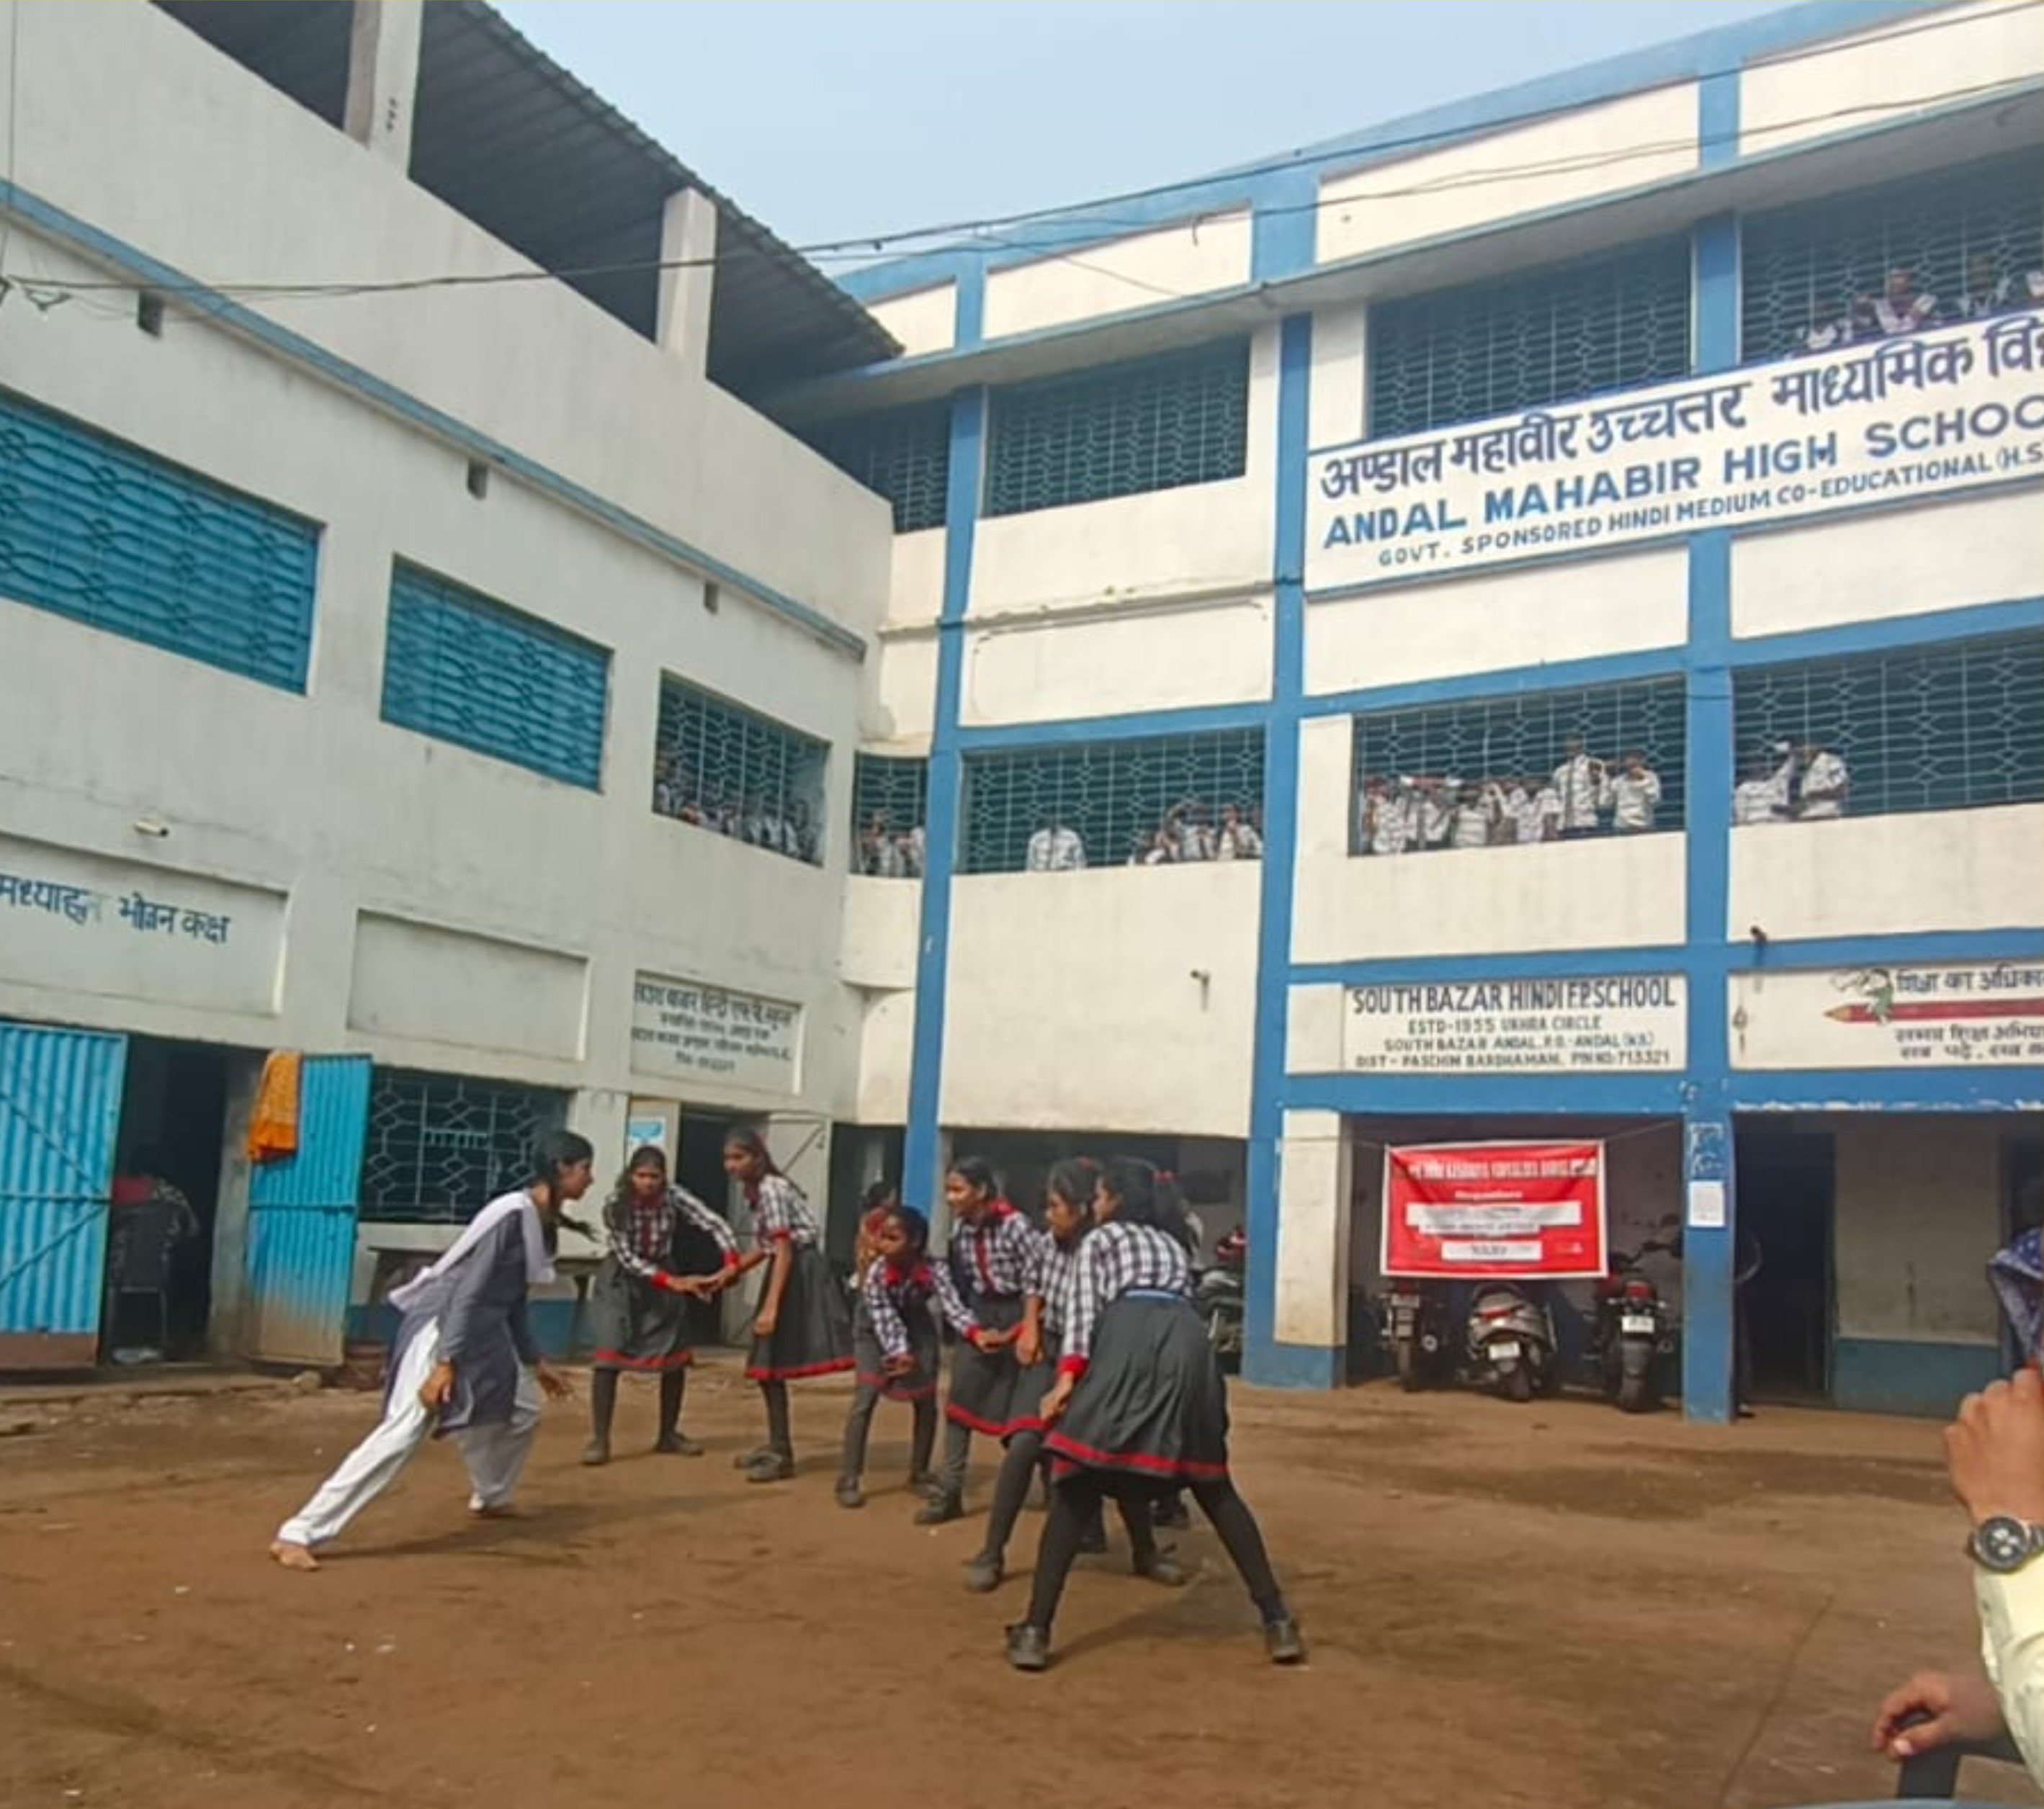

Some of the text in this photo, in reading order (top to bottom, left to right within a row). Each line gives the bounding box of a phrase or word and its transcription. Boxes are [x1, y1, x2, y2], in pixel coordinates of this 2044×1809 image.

[1321, 438, 1446, 500] अण्डाल
[1449, 413, 1584, 475] महावीर
[1771, 337, 1975, 416] माध्यमिक
[1323, 498, 1467, 549] ANDAL
[1484, 457, 1701, 524] MAHABIR
[1724, 431, 1837, 485] HIGH
[1378, 542, 1451, 566] GOVT.
[1461, 516, 1602, 555] SPONSORED
[1608, 504, 1670, 531] HINDI
[1677, 488, 1772, 522] MEDIUM
[1777, 451, 1993, 506] CO-EDUCATIONAL
[179, 910, 230, 944] कक्ष
[1353, 987, 1422, 1015] SOUTH
[1427, 984, 1503, 1013] BAZAR
[1510, 979, 1564, 1010] HINDI
[1944, 972, 1974, 990] का
[1551, 1014, 1603, 1031] CIRCLE
[1384, 1038, 1433, 1052] SOUTH
[1437, 1036, 1488, 1051] BAZAR
[1402, 1054, 1462, 1067] PASCHIM
